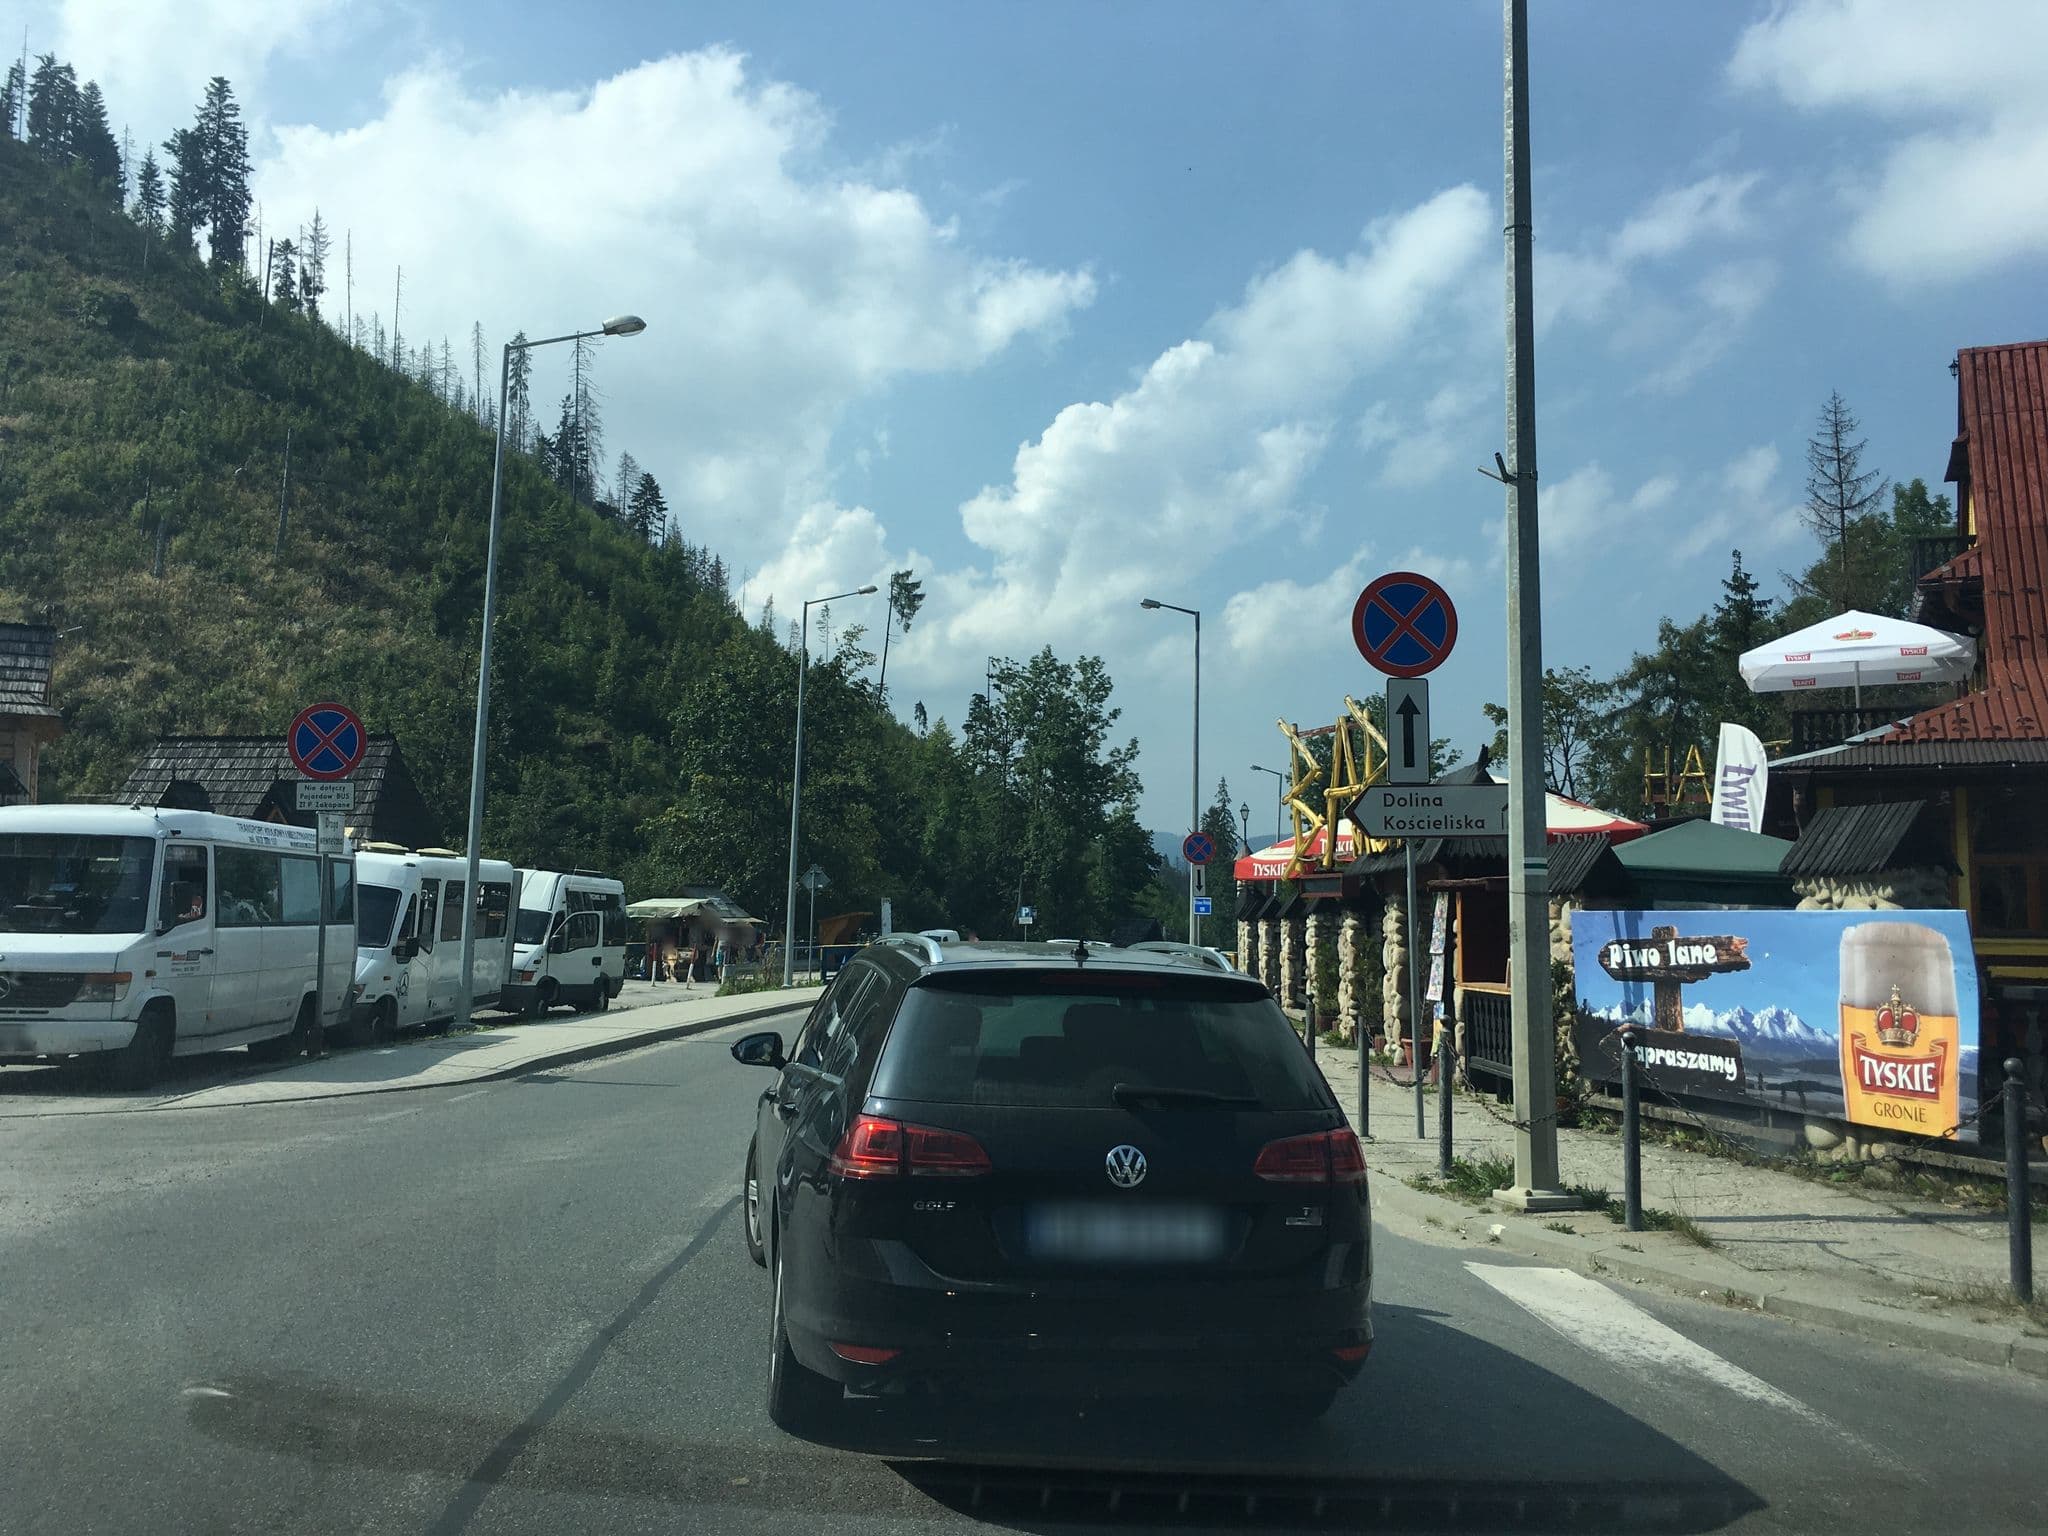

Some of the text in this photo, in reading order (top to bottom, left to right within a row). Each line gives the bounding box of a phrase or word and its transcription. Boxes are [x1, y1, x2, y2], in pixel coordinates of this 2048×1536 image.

[336, 792, 350, 800] BUS
[1383, 793, 1443, 808] Dolina
[315, 801, 350, 809] Zakopane
[1383, 815, 1486, 830] Kościeliska
[1608, 940, 1718, 969] Piwo lane
[1621, 1038, 1738, 1081] apraszamy
[1859, 1054, 1937, 1093] TYSKIE
[1873, 1101, 1927, 1123] GRONIE
[912, 1200, 957, 1212] GOLF
